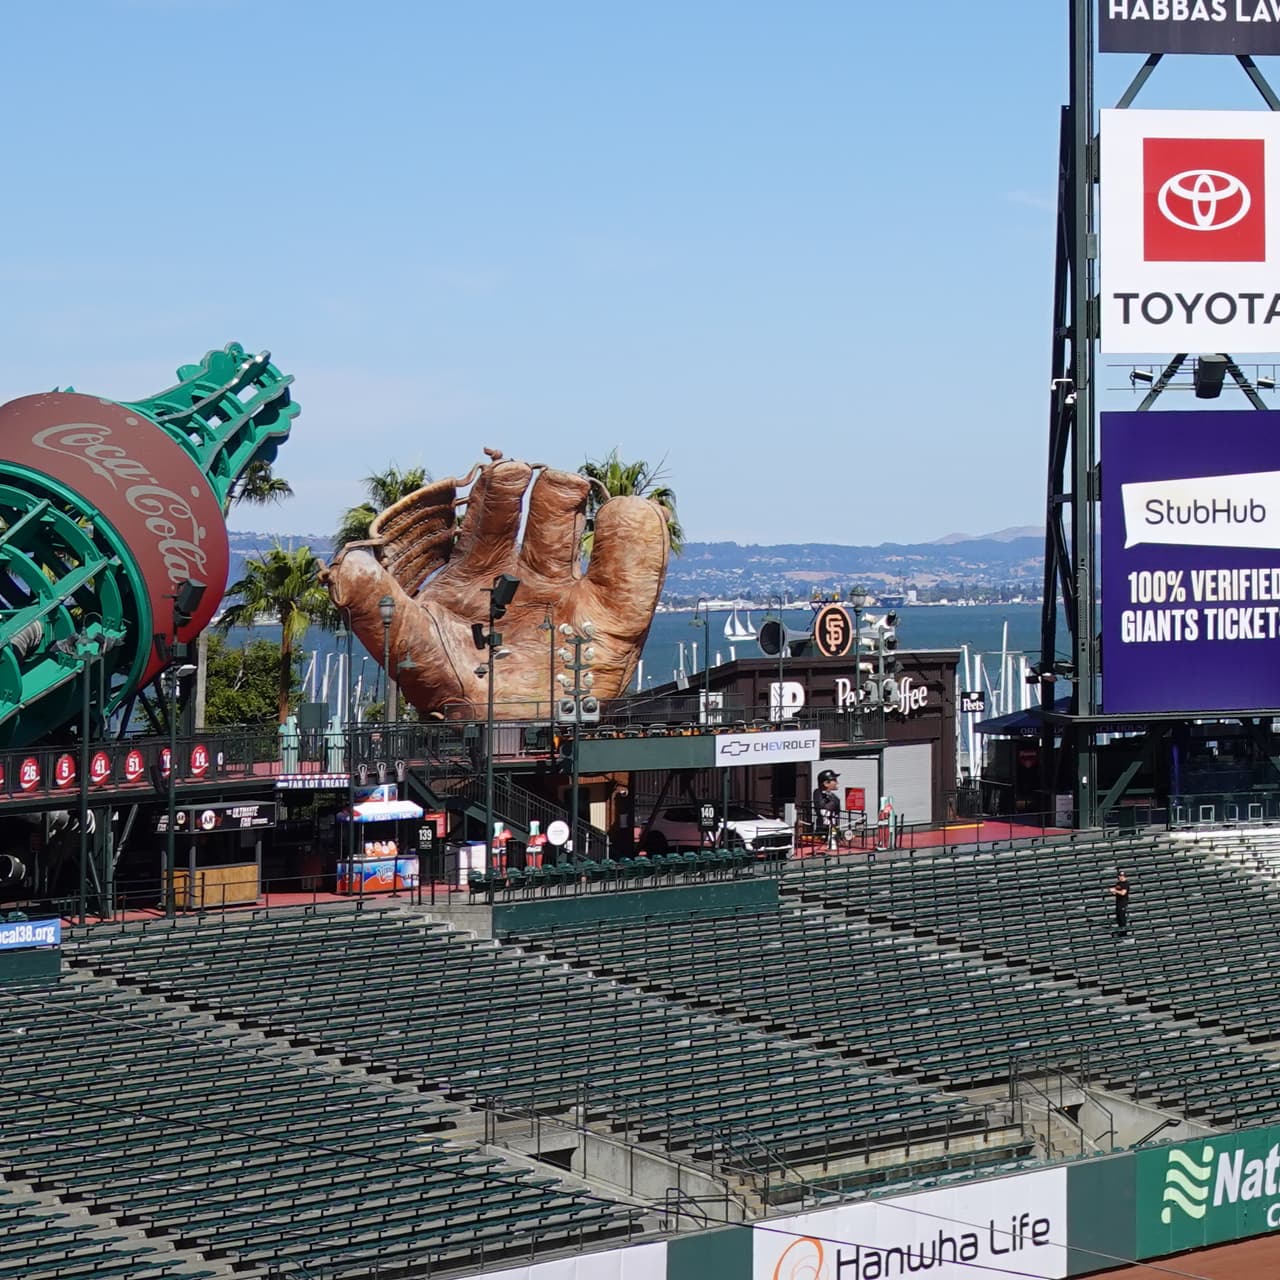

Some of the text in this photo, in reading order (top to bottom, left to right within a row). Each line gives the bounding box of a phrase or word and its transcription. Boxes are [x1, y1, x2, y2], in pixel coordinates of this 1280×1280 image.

[31, 422, 209, 585] Coca-Cola
[1144, 498, 1267, 525] StubHub
[1128, 570, 1186, 603] 100%
[1121, 608, 1199, 643] GIANTS
[753, 739, 816, 752] CHEVROLET
[62, 762, 69, 777] 5
[95, 759, 105, 774] 41
[129, 757, 139, 772] 51
[24, 766, 36, 780] 26
[305, 780, 318, 788] LOT
[321, 779, 349, 788] TREATS
[701, 807, 714, 818] 140
[418, 829, 432, 841] 139
[0, 925, 55, 944] cal38.org
[836, 1212, 1050, 1280] Hanwha Life
